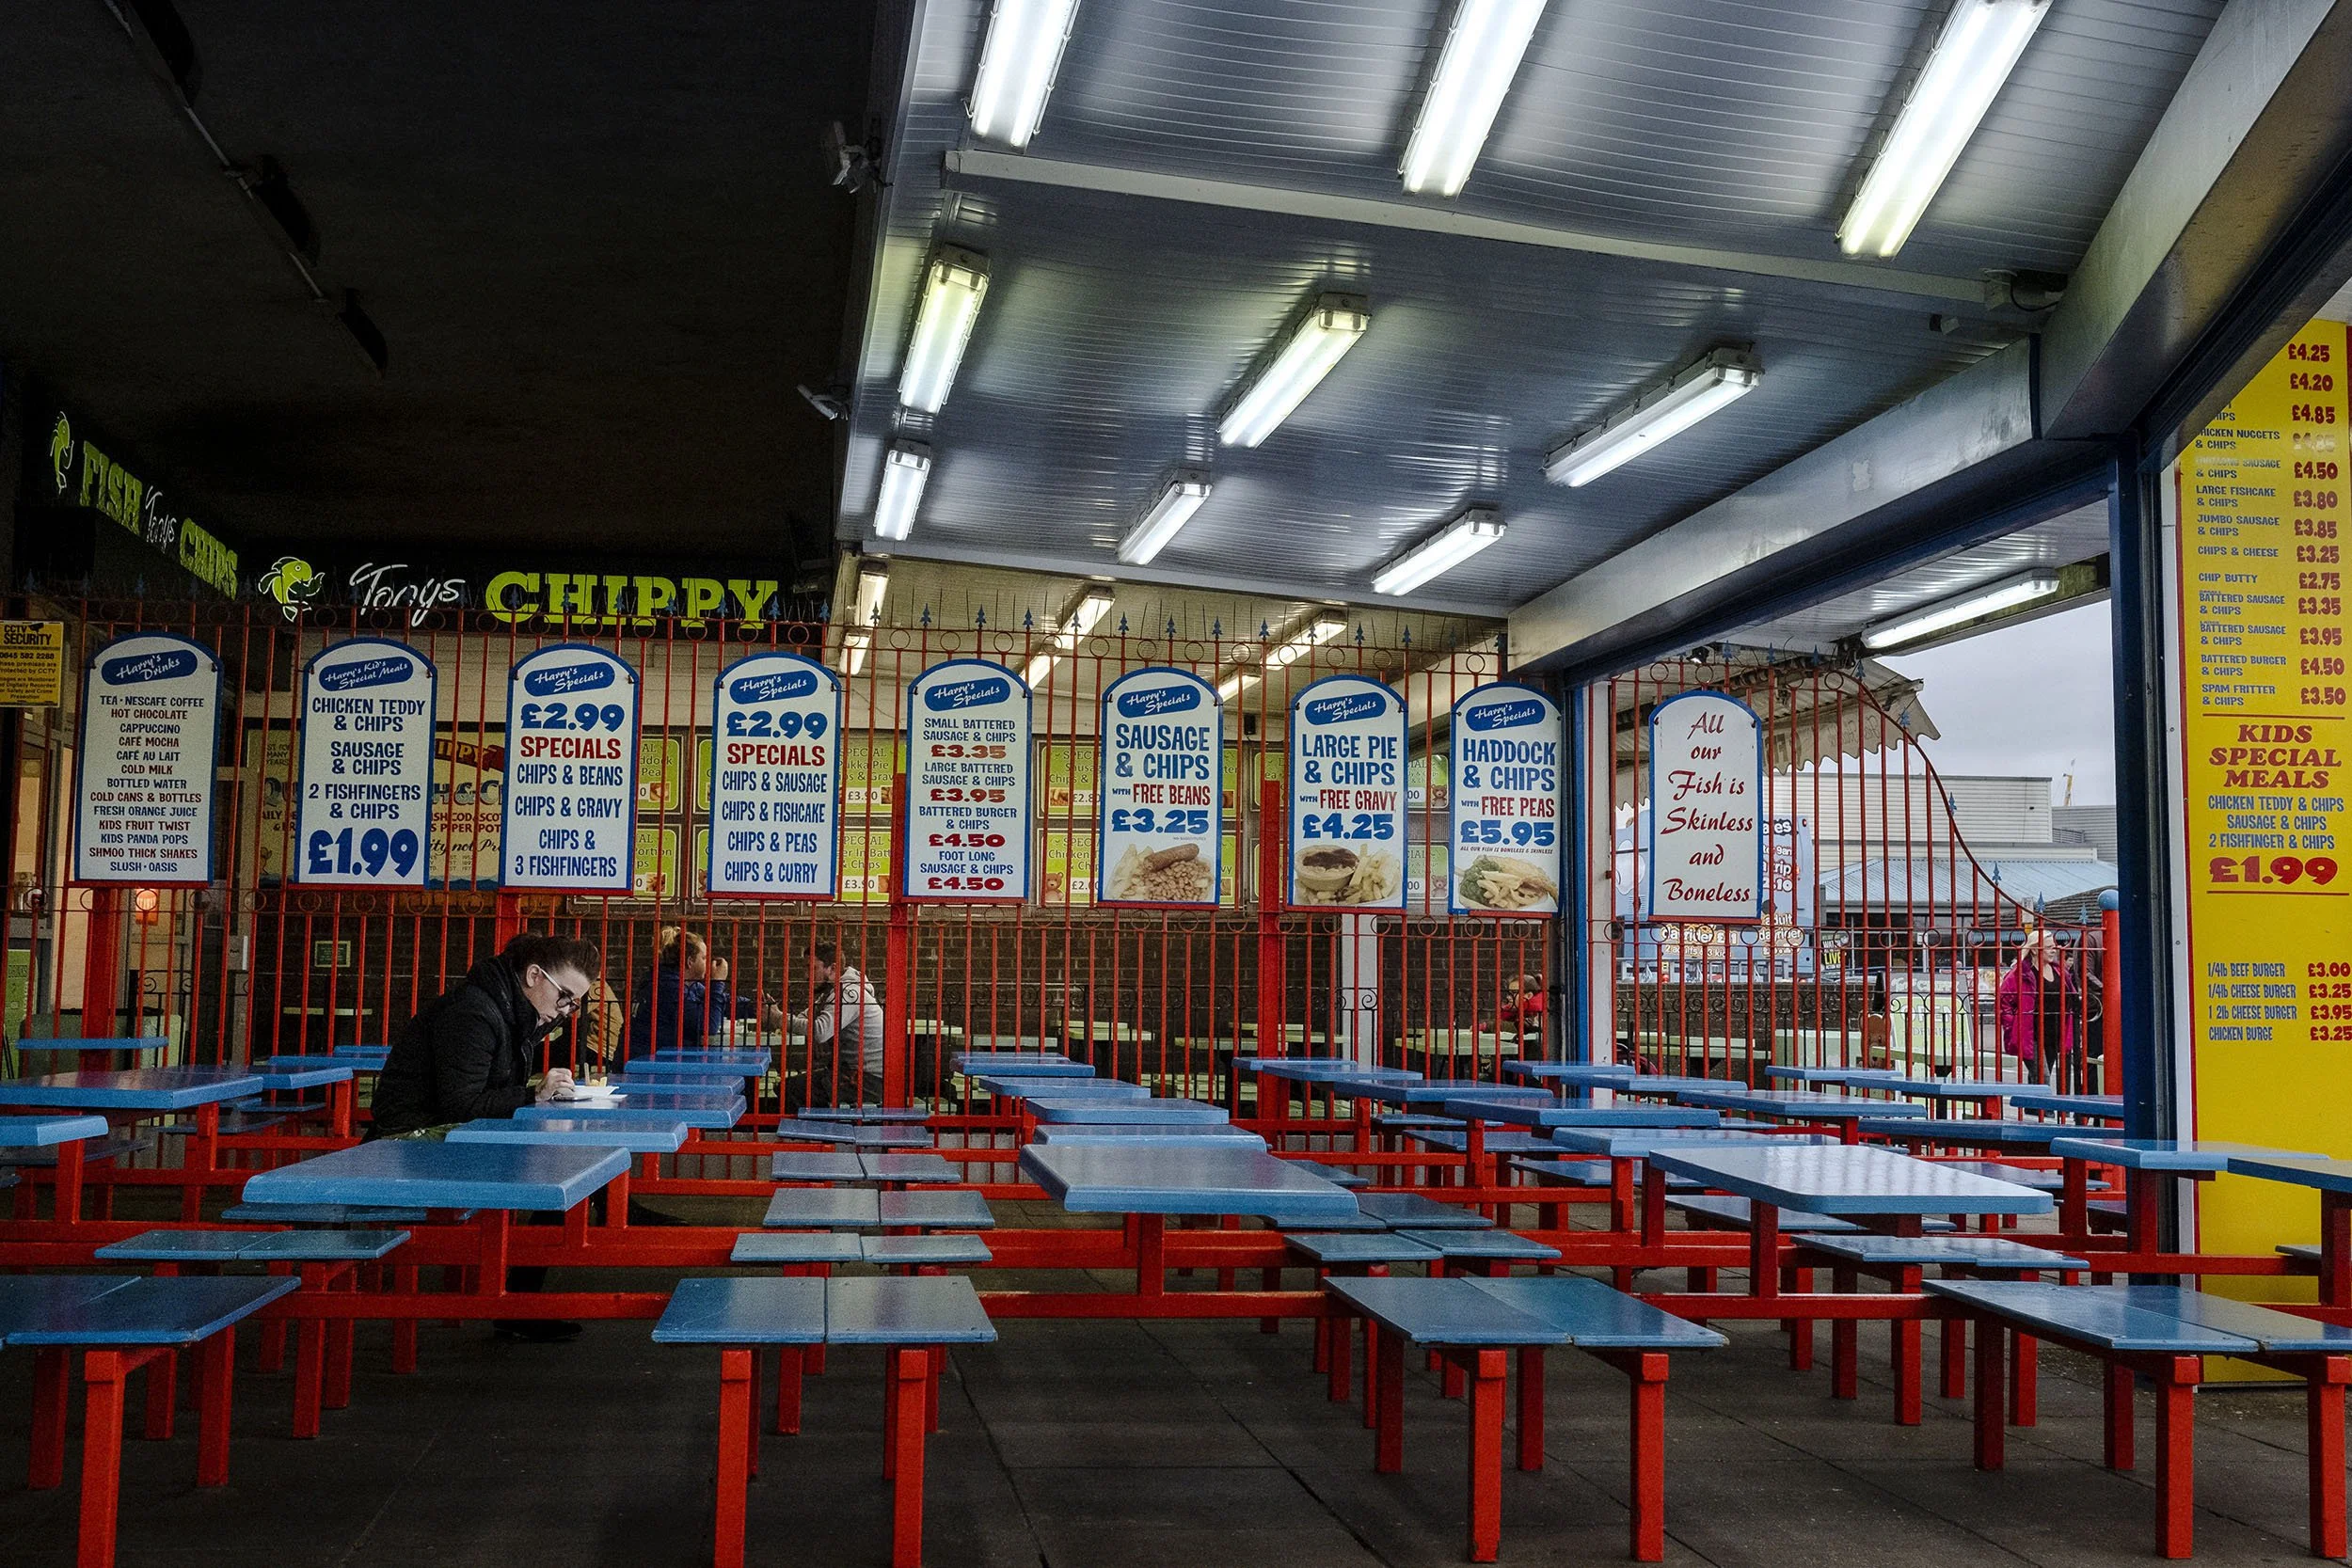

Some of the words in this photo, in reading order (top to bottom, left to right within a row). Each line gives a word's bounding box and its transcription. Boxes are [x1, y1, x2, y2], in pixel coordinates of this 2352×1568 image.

[2288, 343, 2330, 362] £4.25
[2290, 372, 2333, 391] £4.20
[2292, 404, 2335, 424] £4.85
[2294, 461, 2338, 480] £4.50
[2196, 484, 2227, 495] LARGE
[2230, 486, 2276, 497] FISHCAKE
[2294, 489, 2338, 510] £3.80
[2197, 515, 2233, 524] JUMBO
[2236, 515, 2280, 526] SAUSAGE
[2294, 518, 2337, 539] £3.85
[2199, 573, 2221, 581] CHIP
[2224, 574, 2258, 583] BUTTY
[2298, 572, 2341, 591] £2.75
[485, 570, 778, 630] CHIPPY
[4, 625, 27, 633] CCTV
[3, 633, 52, 645] SECURITY
[115, 654, 162, 678] Harry's
[141, 657, 181, 681] Drinks
[2201, 654, 2248, 664] BATTERED
[2250, 656, 2286, 665] BURGER
[2300, 657, 2344, 675] £4.50
[325, 666, 361, 683] Harry's
[364, 659, 386, 672] Kid's
[338, 673, 376, 690] Special
[379, 662, 407, 678] Meals
[534, 668, 578, 684] Harry's
[553, 672, 604, 692] Specials
[739, 675, 781, 691] Harry's
[757, 679, 807, 701] Specials
[2201, 684, 2230, 693] SPAM
[2233, 685, 2276, 694] FRITTER
[100, 695, 118, 705] TEA
[125, 696, 167, 706] NESCAFE
[170, 697, 204, 707] COFFEE
[2300, 687, 2346, 705] £3.50
[111, 708, 131, 719] HOT
[134, 709, 188, 720] CHOCOLATE
[312, 697, 373, 714] CHICKEN
[379, 699, 425, 716] TEDDY
[334, 715, 347, 731] &
[355, 715, 404, 732] CHIPS
[520, 703, 625, 733] £2.99
[726, 710, 828, 740] £2.99
[925, 718, 959, 728] SMALL
[962, 719, 1015, 730] BATTERED
[1687, 711, 1724, 740] All
[119, 723, 181, 734] CAPPUCCINO
[1116, 723, 1210, 751] SAUSAGE
[2237, 724, 2312, 743] KIDS
[119, 736, 142, 746] CAFÉ
[145, 736, 179, 747] MOCHA
[330, 741, 405, 758] SAUSAGE
[520, 736, 621, 759] SPECIALS
[1302, 734, 1360, 758] LARGE
[1368, 736, 1397, 759] PIE
[727, 743, 825, 767] SPECIALS
[930, 744, 1007, 759] £3.35
[1463, 738, 1543, 765] HADDOCK
[1691, 746, 1722, 760] our
[2209, 747, 2342, 768] SPECIAL
[121, 764, 145, 774] COLD
[149, 765, 173, 775] MILK
[517, 763, 557, 784] CHIPS
[563, 765, 573, 784] &
[580, 766, 623, 786] BEANS
[2223, 769, 2329, 789] MEALS
[107, 778, 150, 788] BOTTLED
[153, 779, 187, 789] WATER
[723, 770, 756, 791] CHIPS
[761, 771, 771, 791] &
[775, 771, 827, 793] SAUSAGE
[1668, 770, 1722, 800] Fish
[1729, 778, 1744, 795] is
[309, 784, 319, 799] 2
[326, 784, 421, 800] FISHFINGERS
[1133, 784, 1164, 803] FREE
[1168, 784, 1211, 806] BEANS
[1320, 789, 1350, 810] FREE
[1355, 790, 1397, 811] GRAVY
[94, 805, 125, 816] FRESH
[128, 806, 167, 816] ORANGE
[169, 807, 198, 816] JUICE
[722, 800, 755, 821] CHIPS
[759, 801, 769, 821] &
[773, 802, 825, 823] FISHCAKE
[919, 806, 972, 816] BATTERED
[976, 807, 1017, 818] BURGER
[1482, 796, 1515, 816] FREE
[1519, 797, 1555, 817] PEAS
[2208, 795, 2254, 810] CHICKEN
[2258, 796, 2294, 811] TEDDY
[2297, 797, 2307, 811] &
[2312, 798, 2344, 812] CHIPS
[99, 820, 121, 830] KIDS
[125, 820, 154, 831] FRUIT
[158, 821, 191, 831] TWIST
[1111, 808, 1209, 834] £3.25
[1302, 813, 1394, 840] £4.25
[1661, 806, 1753, 834] Skinless
[929, 833, 1006, 847] £4.50
[1460, 819, 1555, 847] £5.95
[89, 847, 124, 858] SHMOO
[128, 847, 156, 858] THICK
[160, 848, 198, 859] SHAKES
[309, 827, 419, 878] £1.99
[939, 850, 965, 861] FOOT
[969, 851, 995, 862] LONG
[1689, 844, 1724, 865] and
[110, 862, 142, 872] SLUSH
[149, 862, 178, 872] OASIS
[515, 855, 524, 876] 3
[530, 855, 616, 878] FISHFINGERS
[2209, 856, 2338, 885] £1.99
[928, 877, 1004, 891] £4.50
[1662, 879, 1750, 902] Boneless
[2208, 962, 2228, 977] 1/4lb
[2230, 962, 2249, 977] BEEF
[2252, 963, 2285, 977] BURGER
[2308, 962, 2351, 977] £3.00
[2208, 983, 2228, 999] 1/4lb
[2231, 984, 2261, 998] CHEESE
[2263, 984, 2296, 999] BURGER
[2309, 983, 2351, 999] £3.25
[2209, 1026, 2243, 1041] CHICKEN
[2310, 1025, 2352, 1041] £3.25
